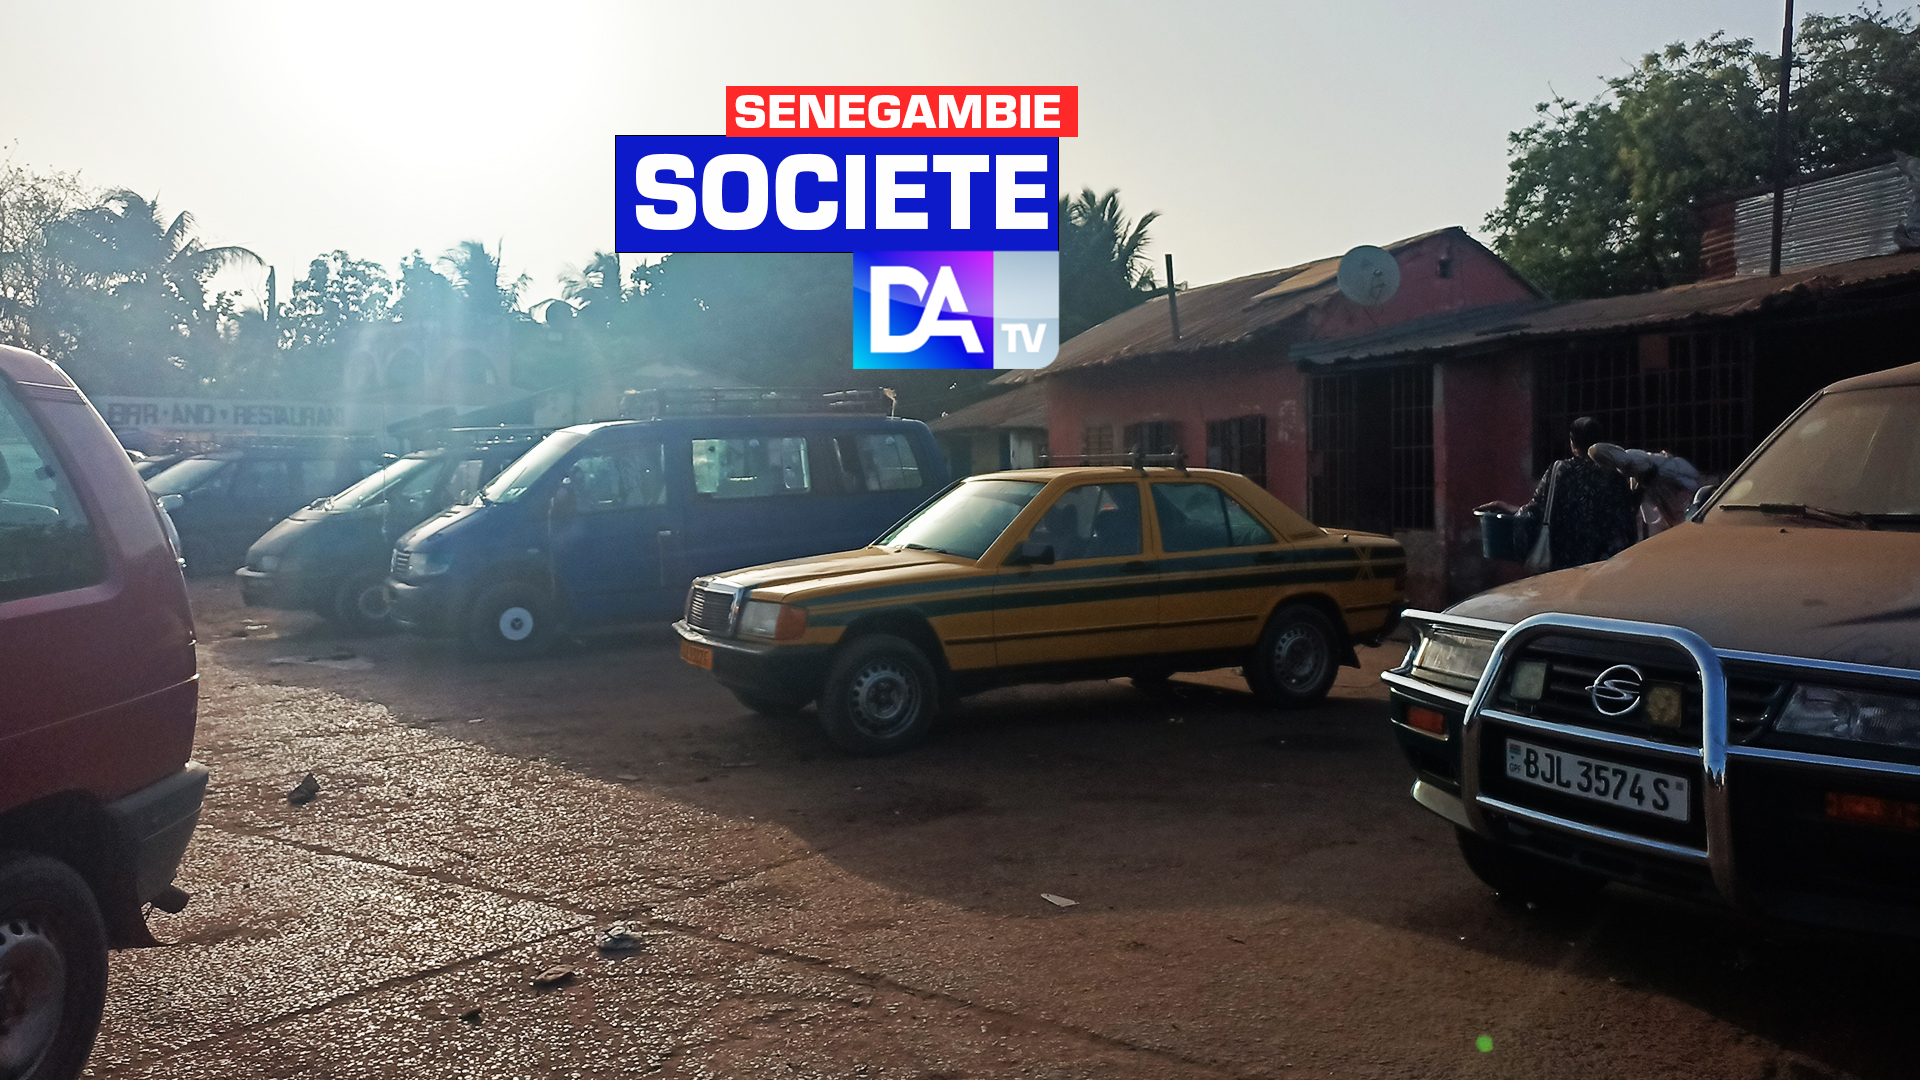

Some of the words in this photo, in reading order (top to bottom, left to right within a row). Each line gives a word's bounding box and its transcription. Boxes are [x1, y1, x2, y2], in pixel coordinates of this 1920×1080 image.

[107, 403, 159, 425] BAR
[172, 404, 215, 424] AND
[1524, 748, 1571, 789] BJL
[1576, 760, 1645, 806] 3574
[1652, 778, 1670, 811] S
